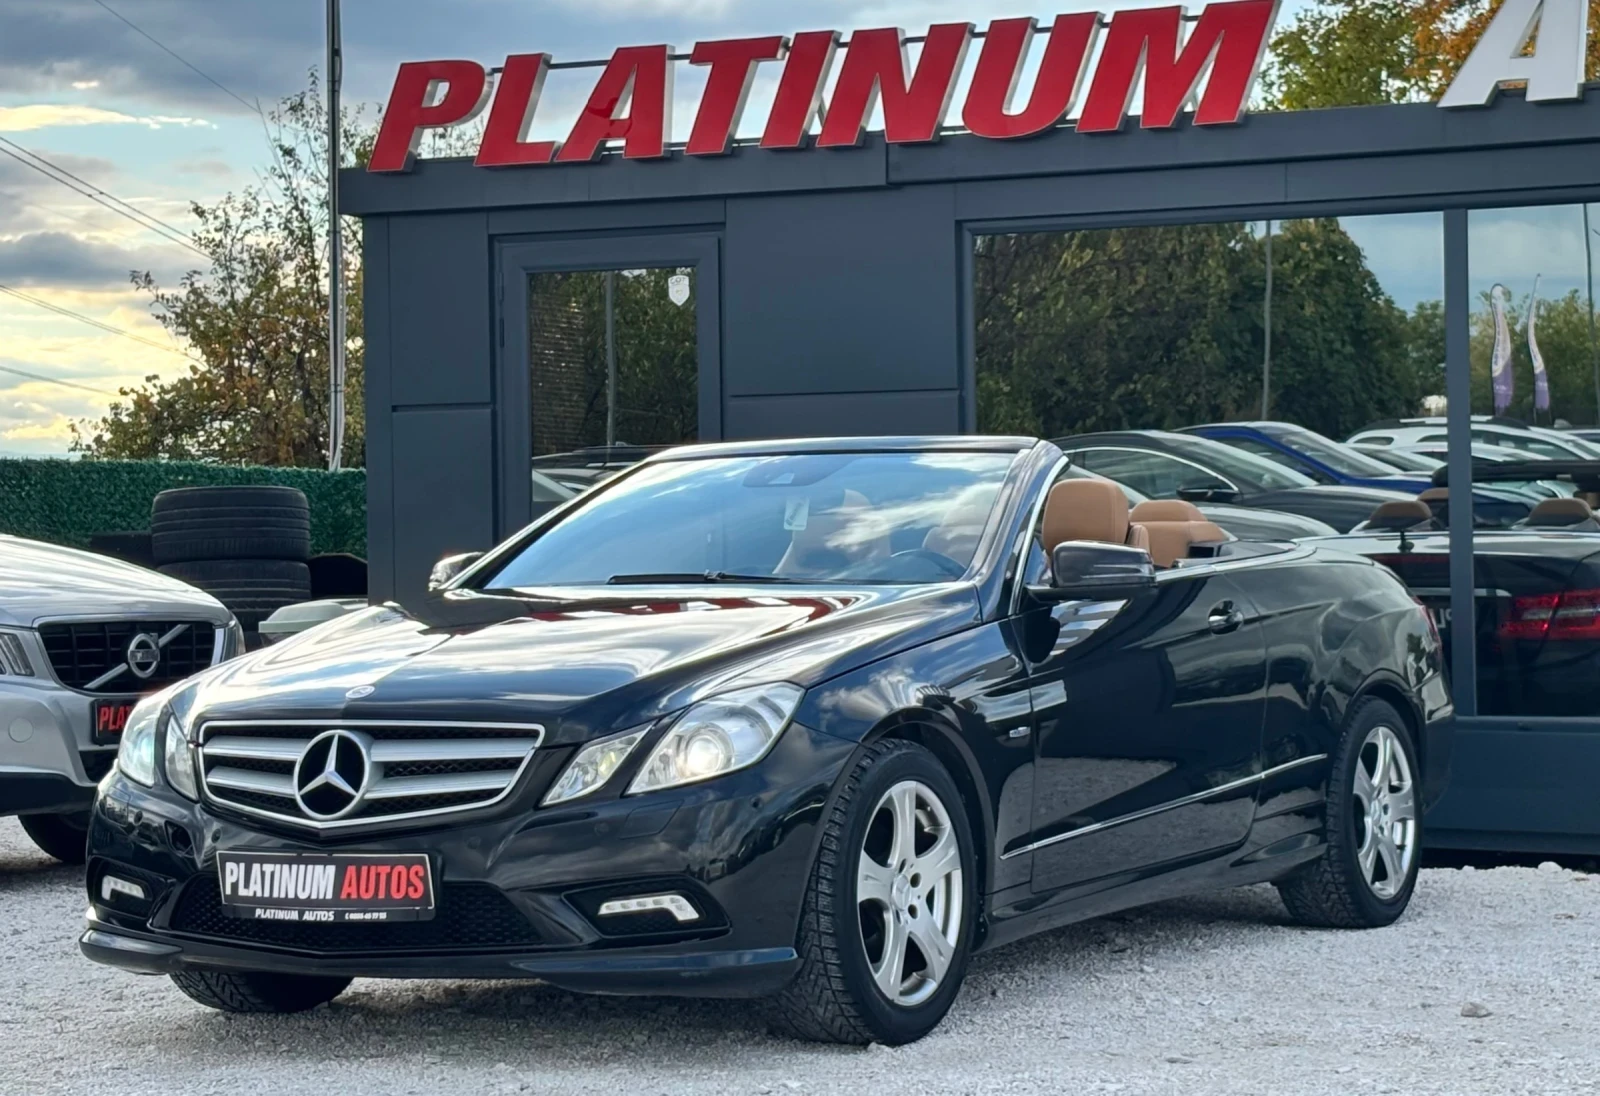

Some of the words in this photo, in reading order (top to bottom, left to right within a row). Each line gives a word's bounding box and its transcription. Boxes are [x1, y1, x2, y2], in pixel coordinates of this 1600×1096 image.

[366, 0, 1280, 173] PLATINUM
[225, 861, 336, 900] PLATINUM
[340, 864, 425, 900] AUTOS
[255, 908, 299, 920] PLATINUM
[302, 910, 335, 921] AUTOS
